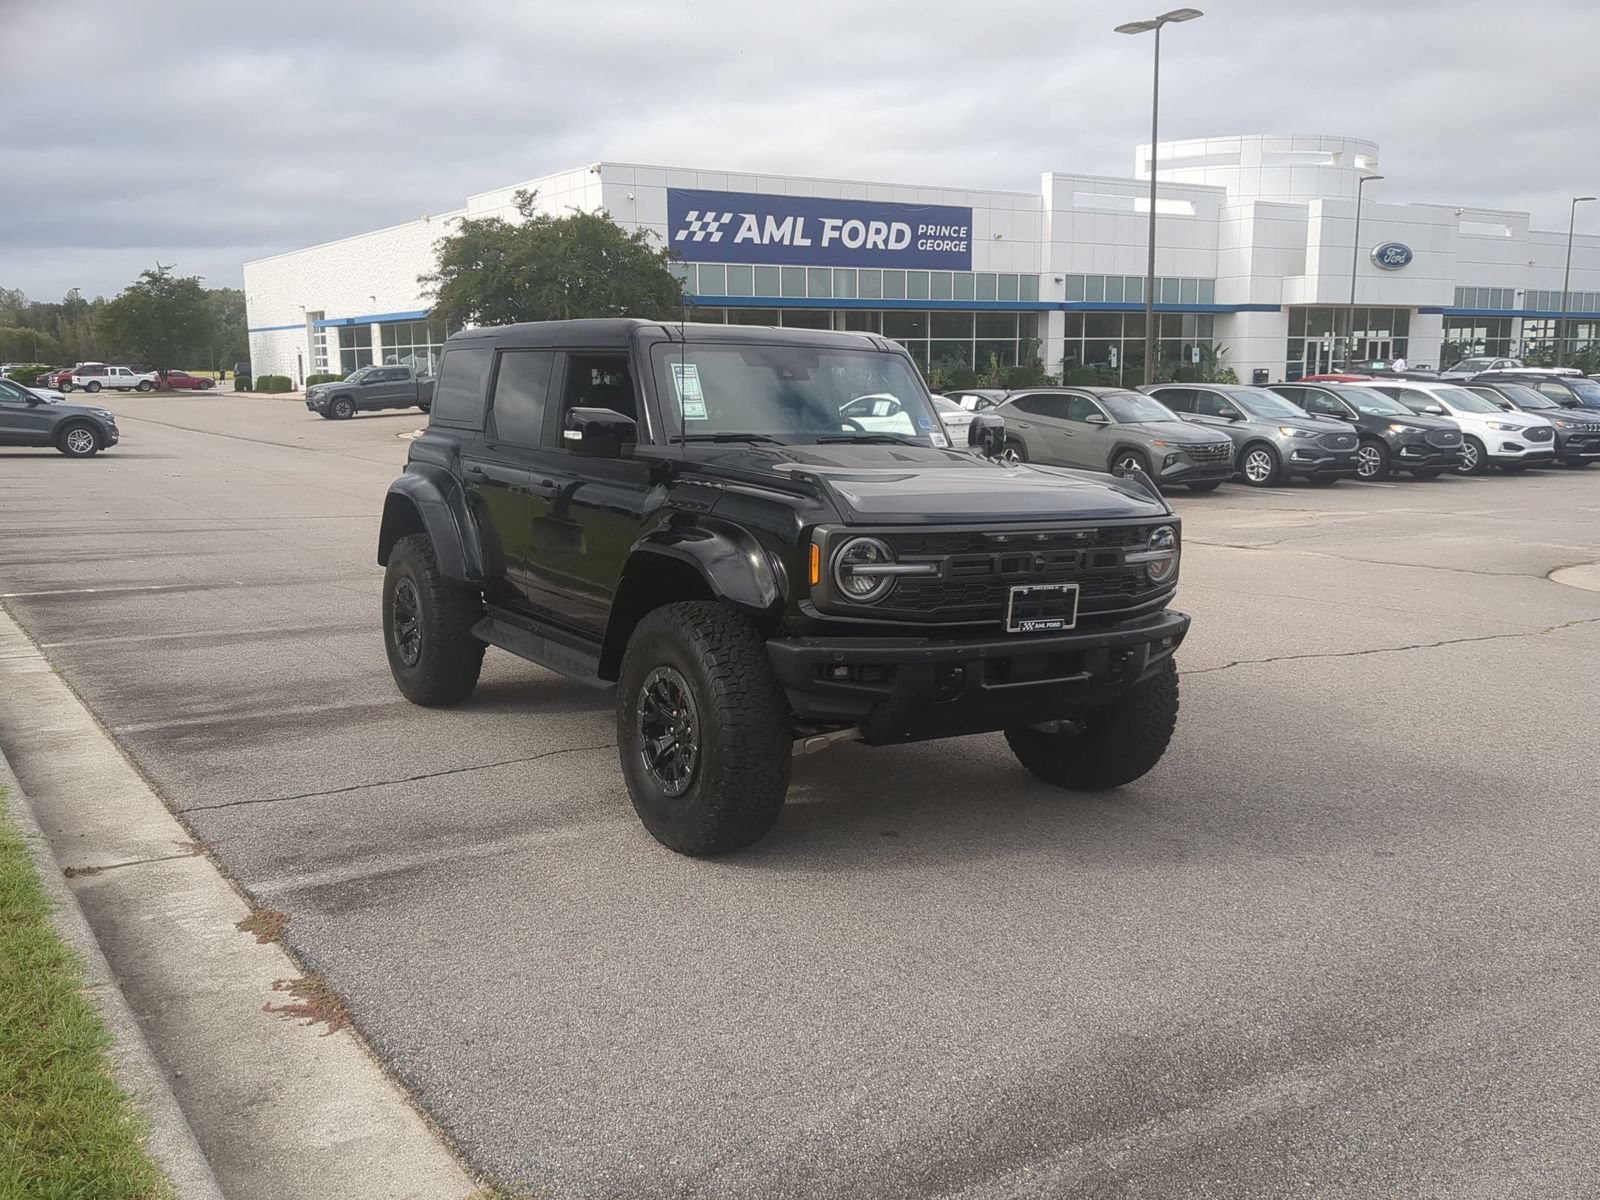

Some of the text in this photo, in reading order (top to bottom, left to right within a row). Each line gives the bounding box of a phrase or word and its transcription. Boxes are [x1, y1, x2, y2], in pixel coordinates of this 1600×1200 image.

[734, 213, 912, 250] AML FORD
[917, 224, 968, 238] PRINCE
[917, 239, 968, 252] GEORGE
[1384, 247, 1407, 263] Ford
